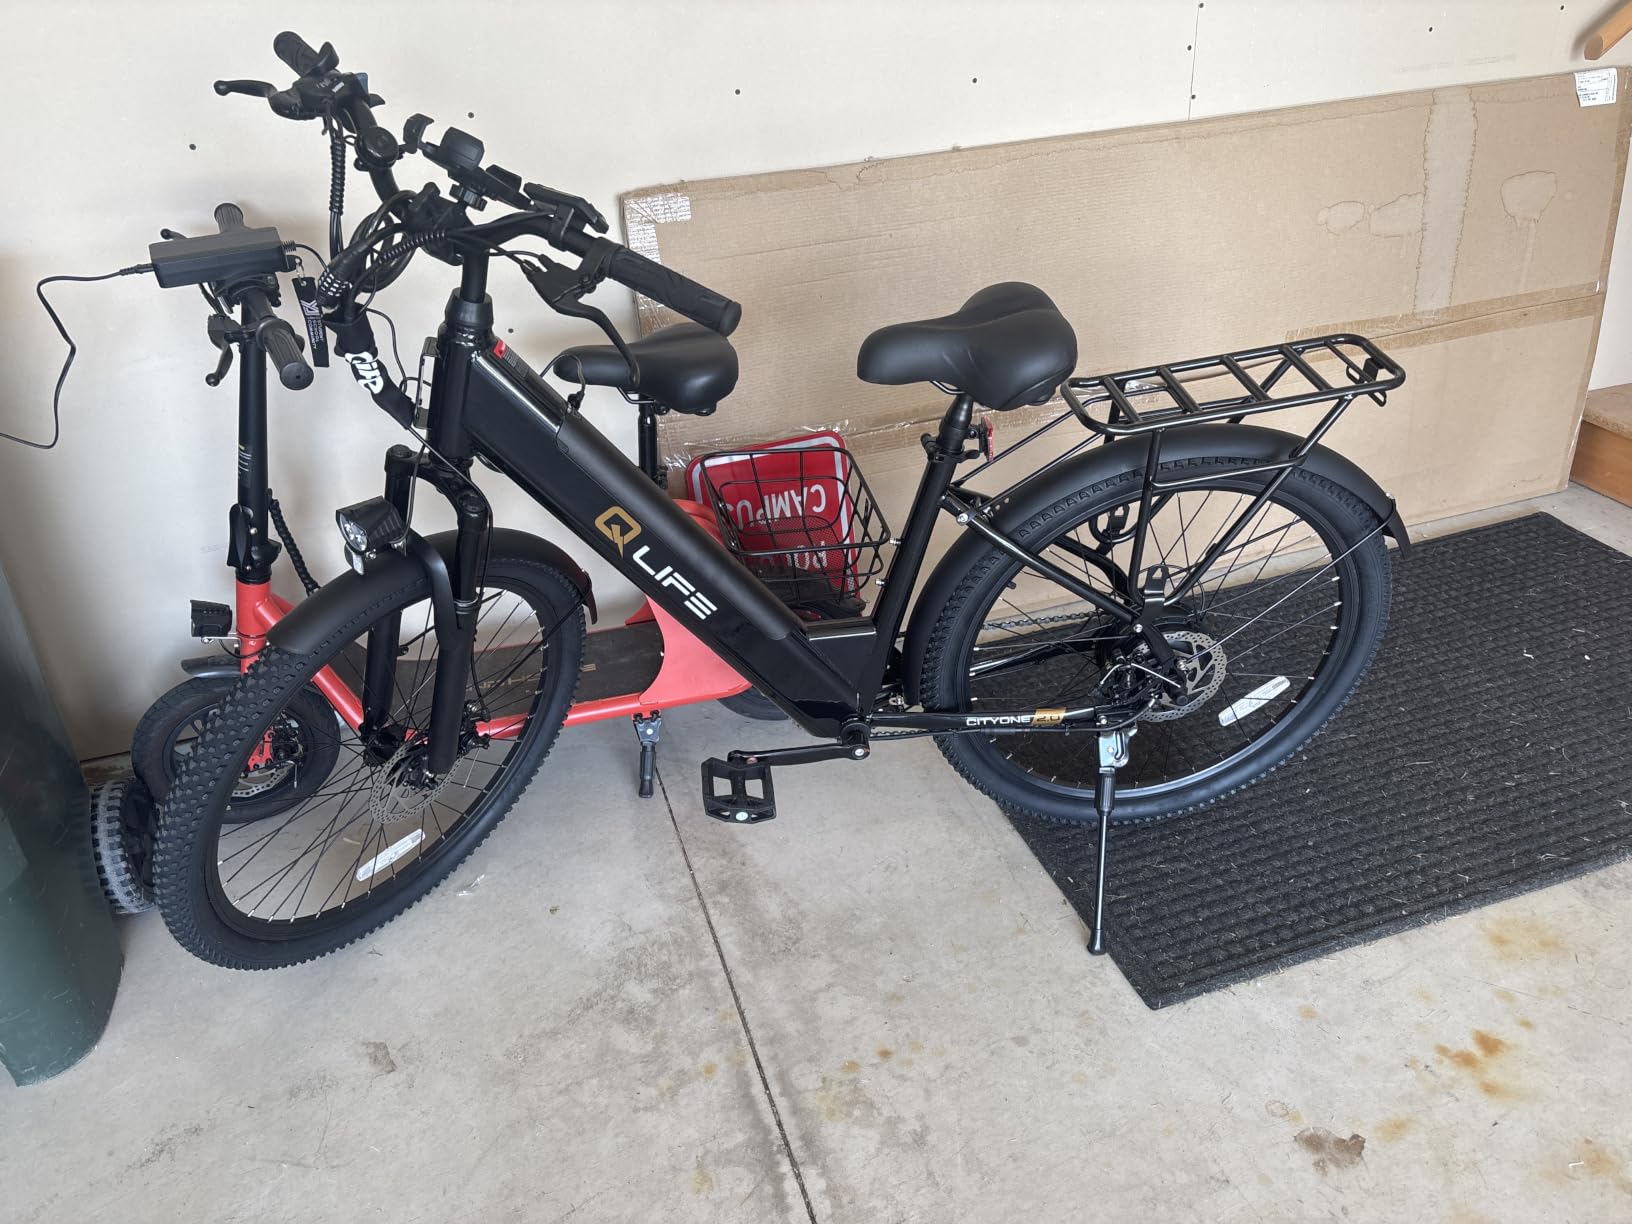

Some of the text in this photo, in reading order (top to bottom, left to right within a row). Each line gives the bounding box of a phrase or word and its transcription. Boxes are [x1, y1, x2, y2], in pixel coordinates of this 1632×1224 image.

[724, 483, 827, 531] CAMPU
[965, 713, 1061, 727] CITYONE 2.0
